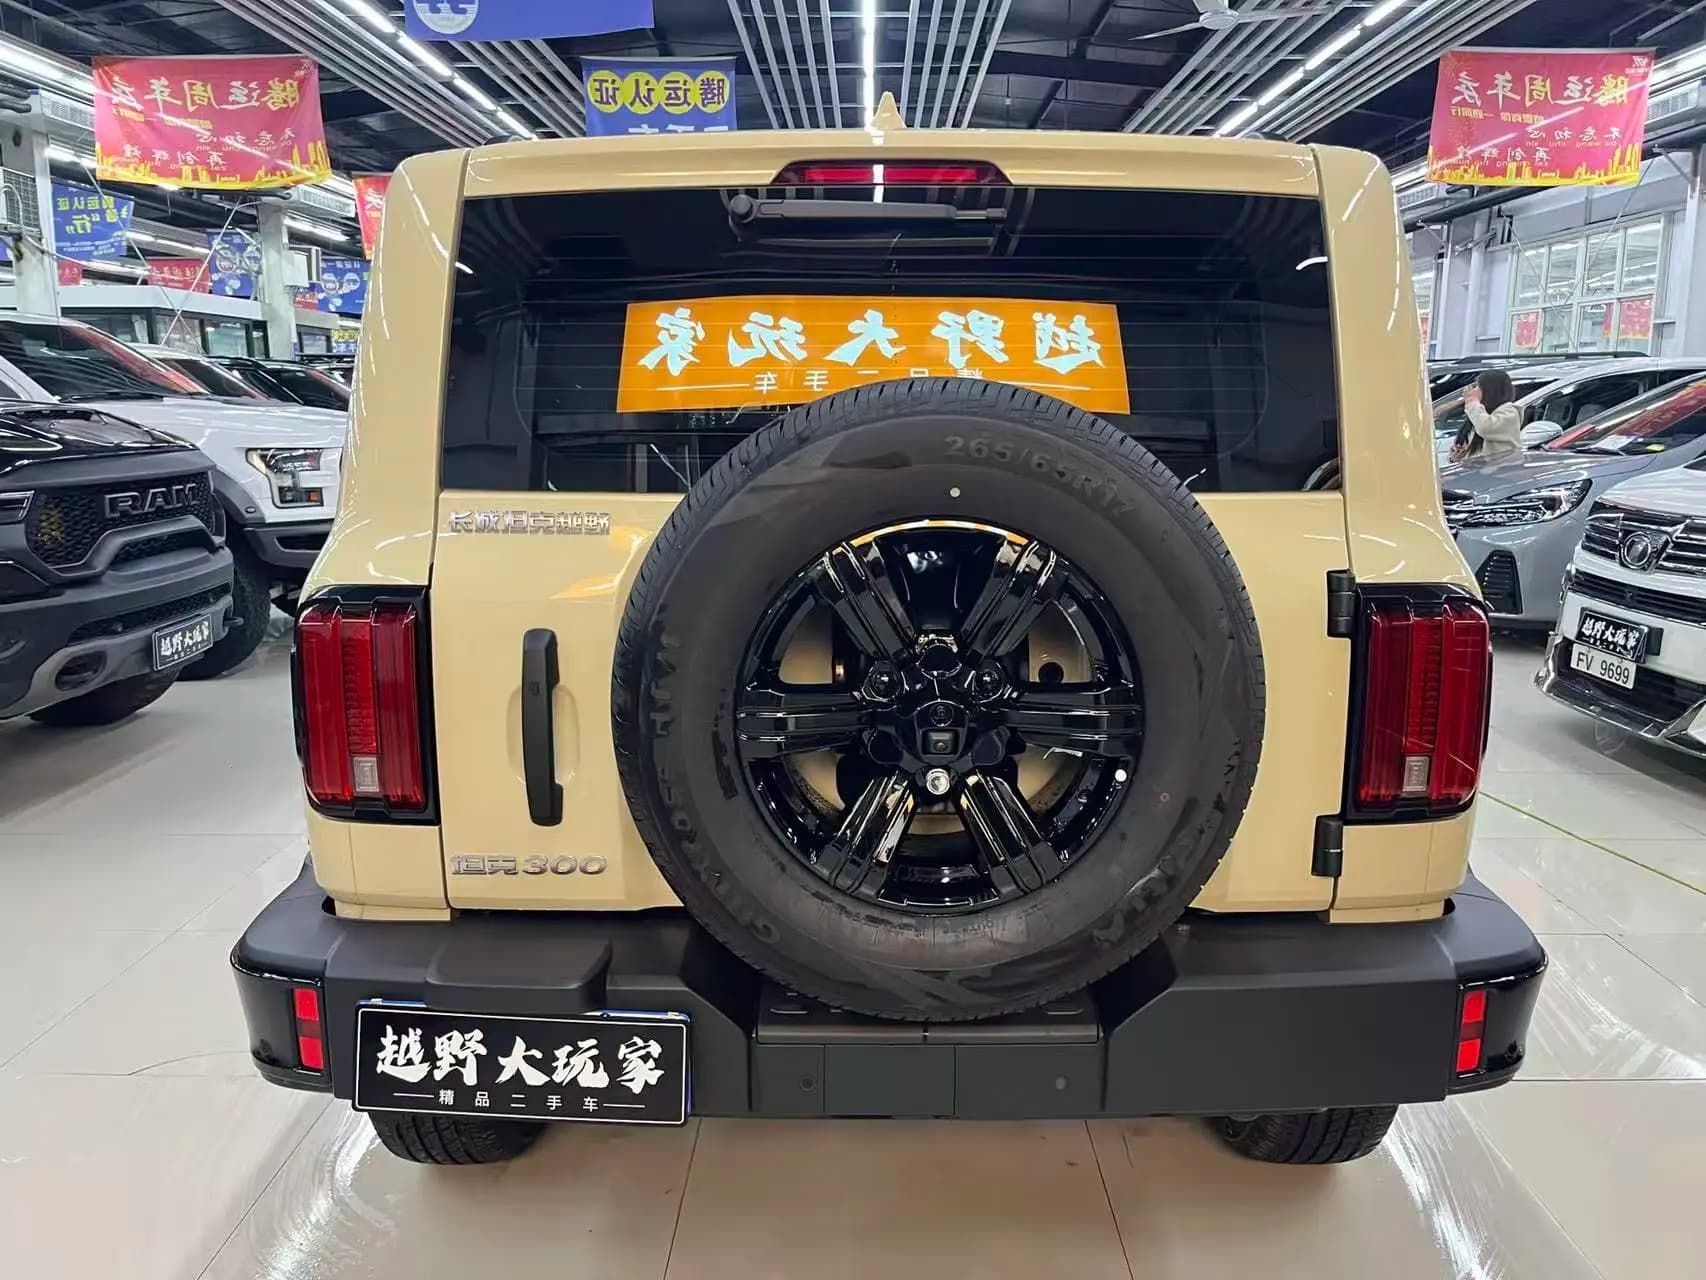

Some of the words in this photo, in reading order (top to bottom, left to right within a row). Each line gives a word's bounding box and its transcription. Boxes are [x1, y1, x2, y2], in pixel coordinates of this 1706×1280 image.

[105, 483, 199, 518] RAM
[449, 510, 611, 536] 长城坦克越野
[1576, 652, 1594, 671] FV
[1600, 660, 1630, 684] 9699
[375, 1025, 666, 1095] 越野大玩家
[438, 1088, 599, 1113] 精品二手车
